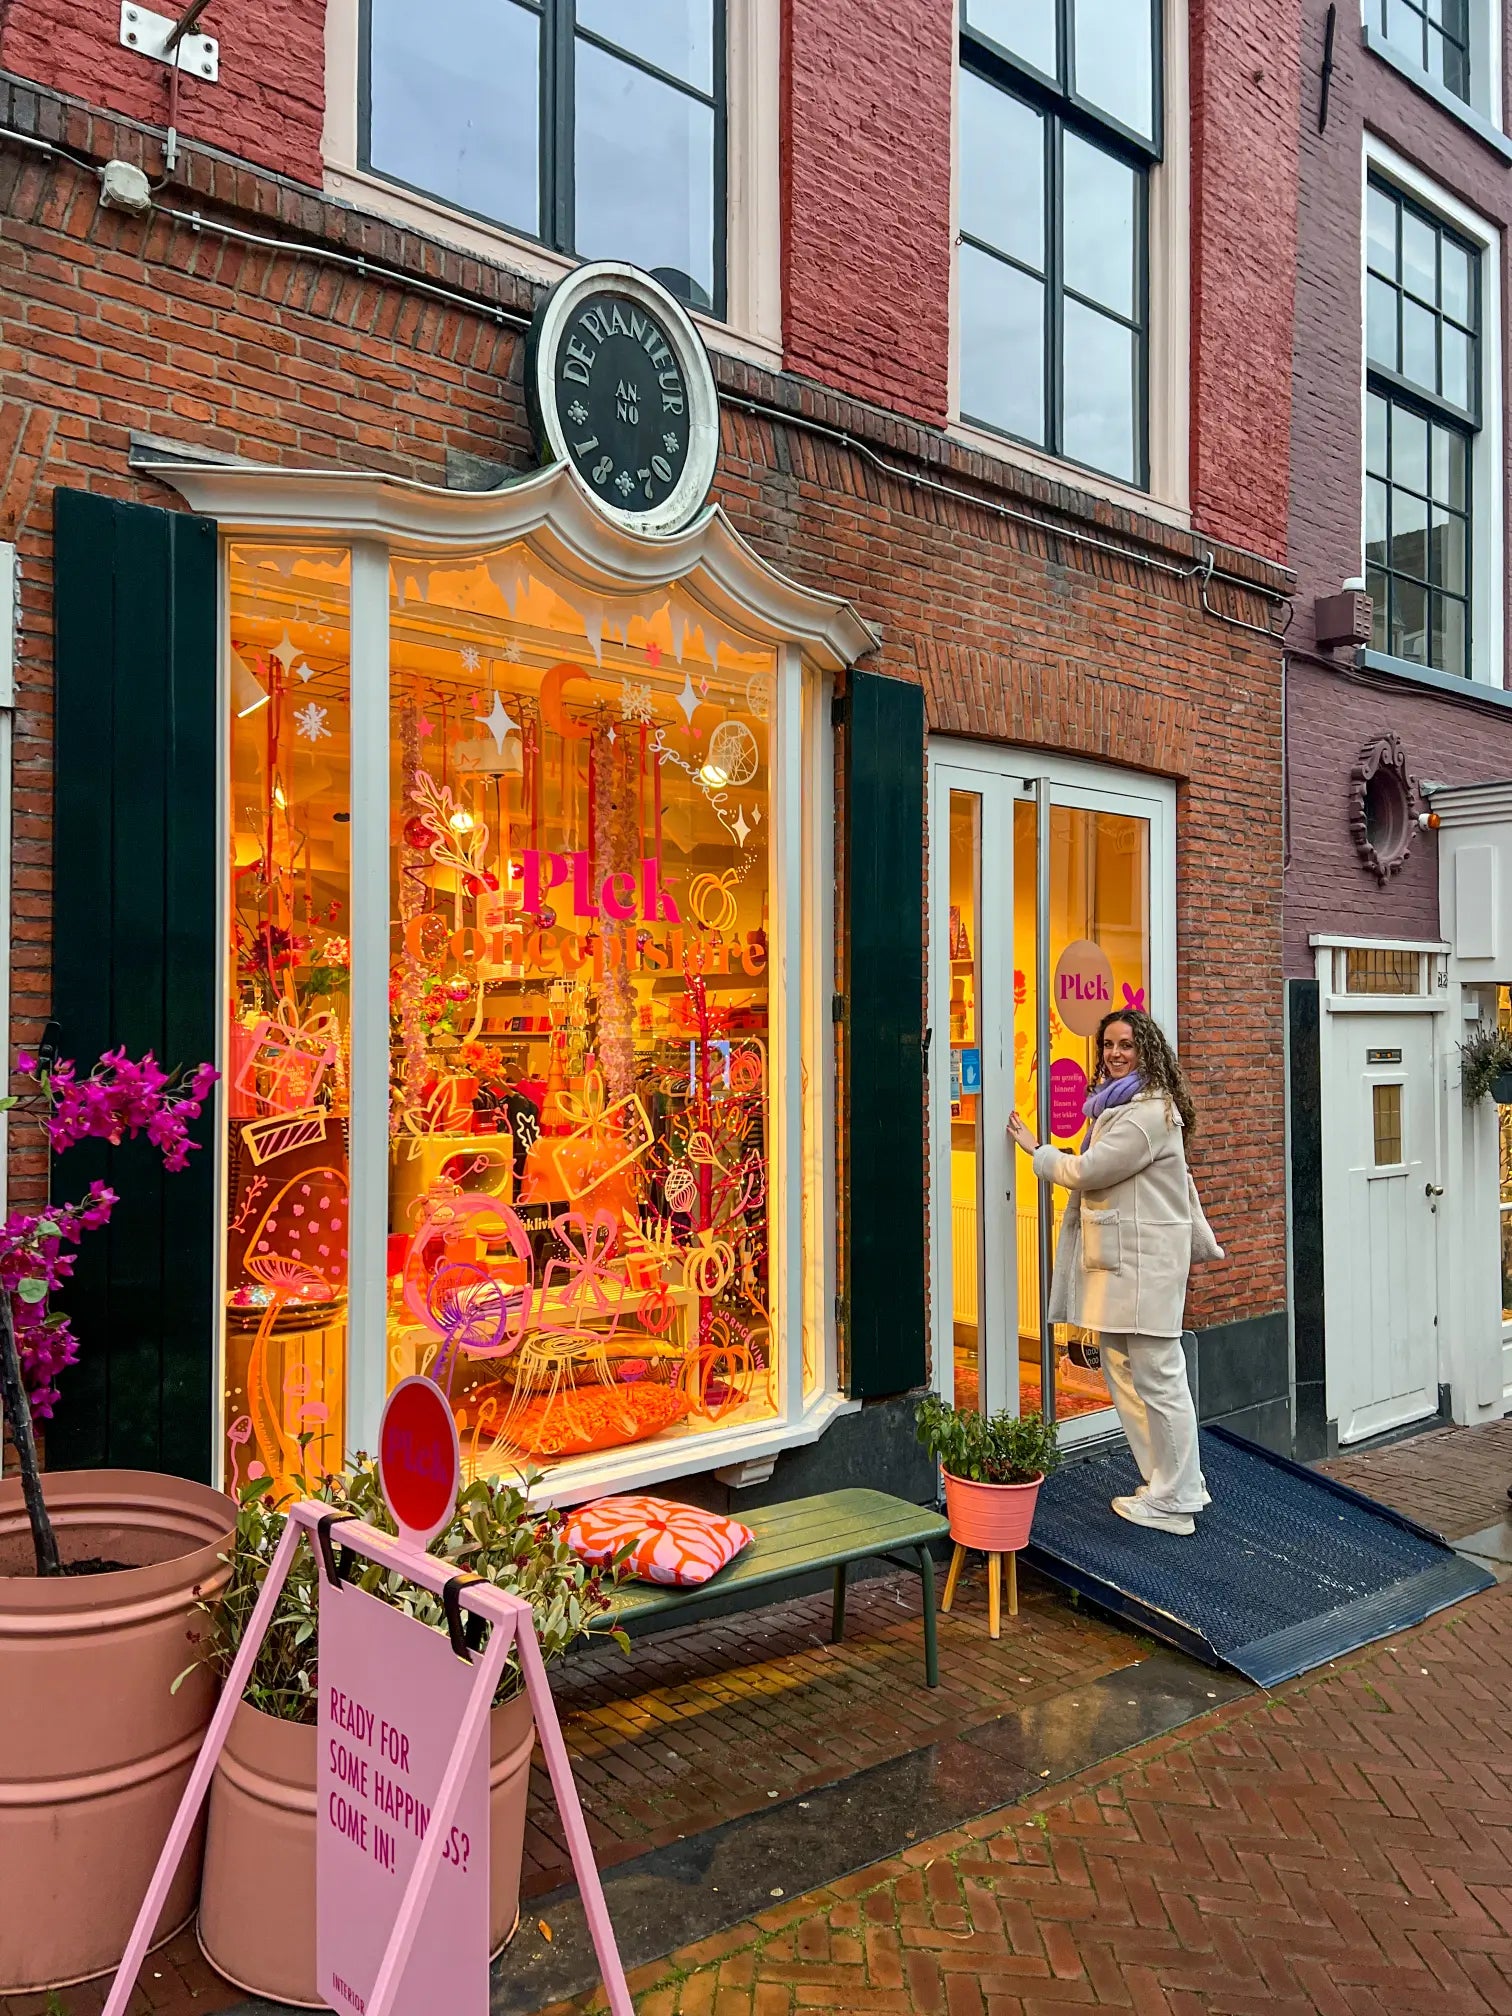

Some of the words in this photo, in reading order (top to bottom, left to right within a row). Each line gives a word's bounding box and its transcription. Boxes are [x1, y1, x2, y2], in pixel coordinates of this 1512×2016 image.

[563, 334, 596, 387] DE
[579, 304, 684, 416] PLANTEUR
[1060, 973, 1109, 1001] Plek
[330, 1686, 375, 1747] READY
[381, 1720, 410, 1775] FOR
[329, 1791, 368, 1852] COME
[374, 1824, 395, 1875] IN!
[330, 1738, 368, 1799] SOME
[374, 1770, 470, 1873] HAPPINS?
[332, 1971, 365, 2016] INTERIOR
